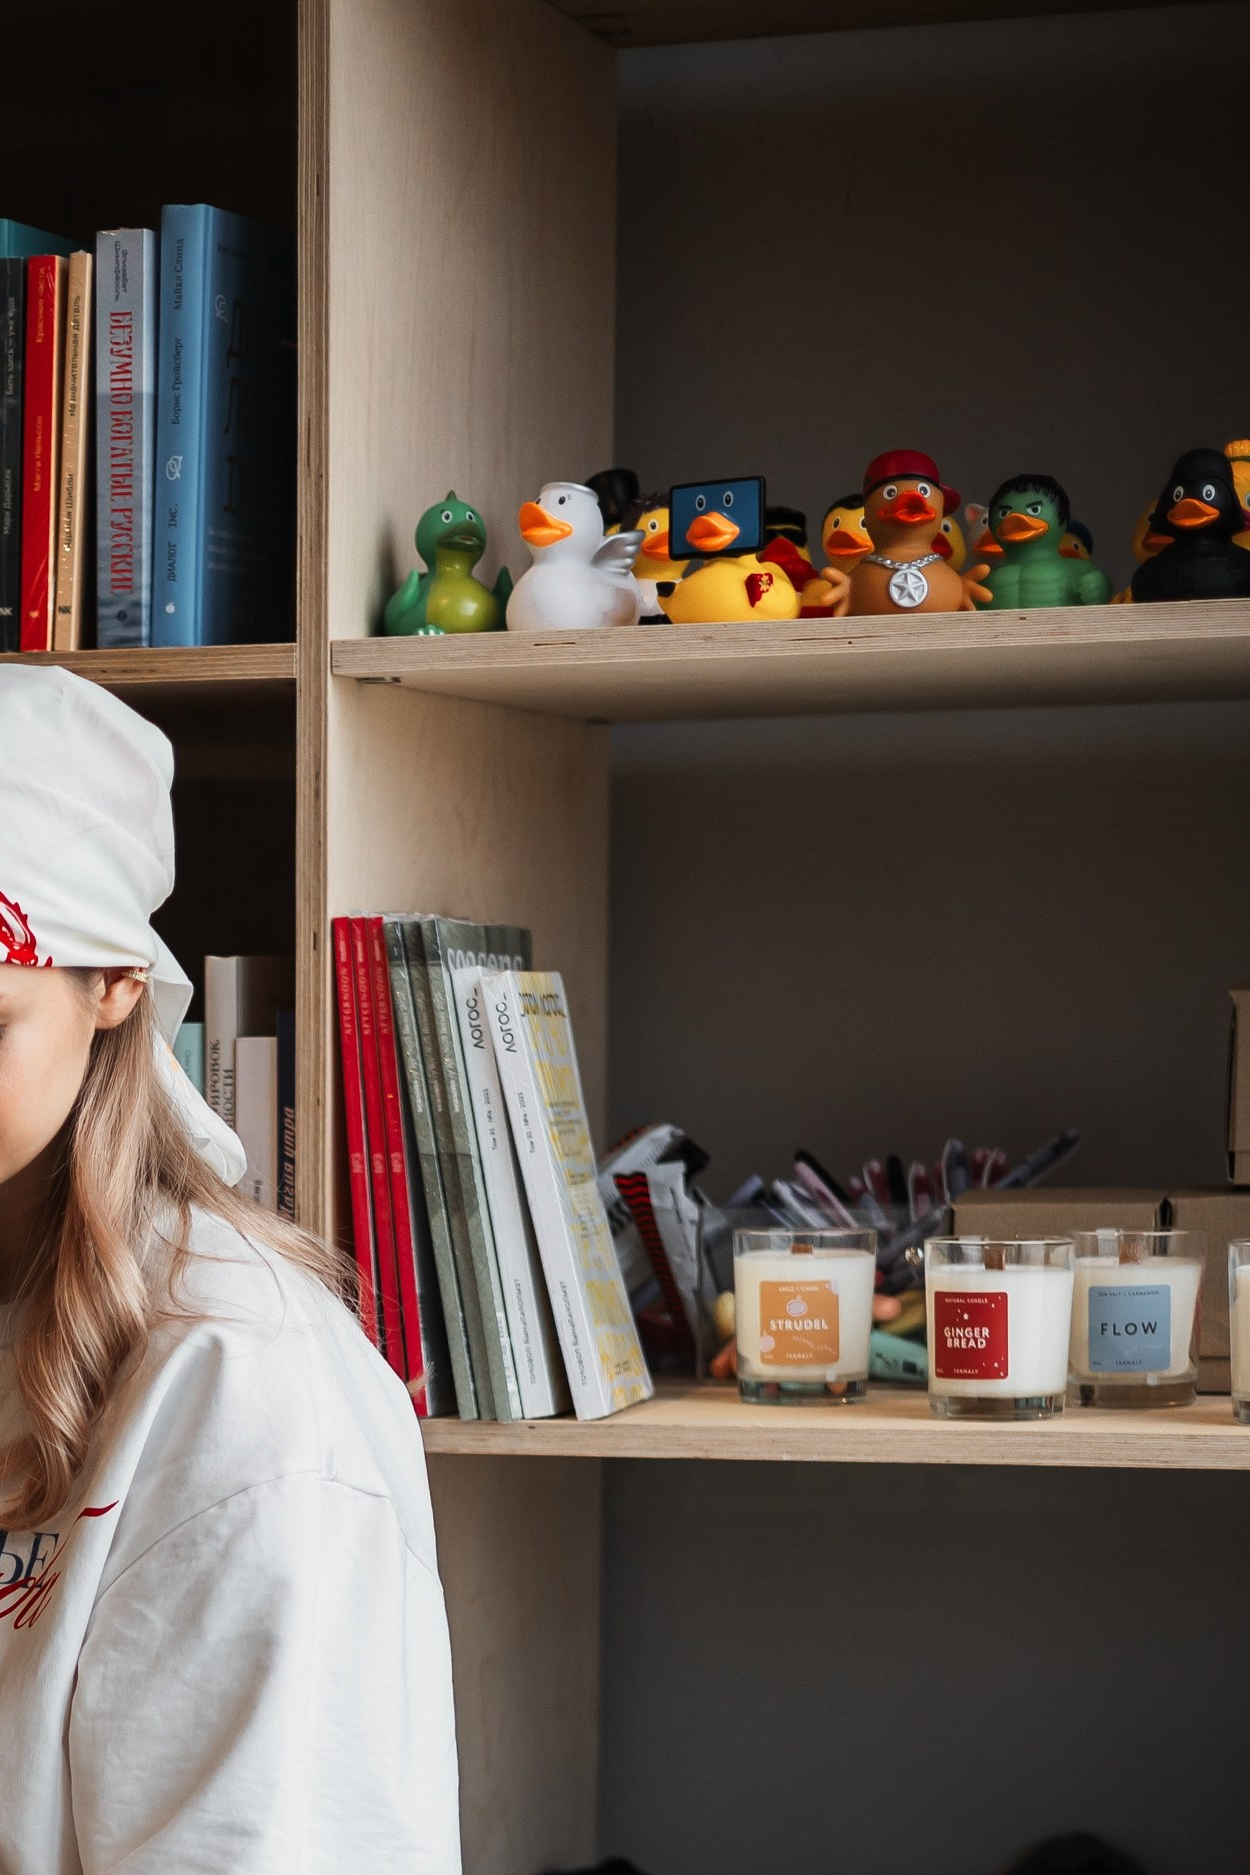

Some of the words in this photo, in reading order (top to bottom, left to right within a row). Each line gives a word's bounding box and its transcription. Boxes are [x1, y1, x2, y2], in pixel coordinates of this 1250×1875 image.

[174, 238, 185, 274] Слинд
[173, 277, 184, 310] Майкл
[35, 299, 47, 343] Красные
[70, 296, 81, 331] деталь
[5, 349, 16, 372] здесь
[109, 310, 134, 405] БЕЗУМНО
[172, 337, 185, 391] Гройсберг
[5, 374, 15, 395] Быть
[171, 395, 182, 425] Борис
[110, 410, 134, 502] БОГАТЫЕ
[64, 473, 74, 509] Шибли
[168, 503, 179, 528] INC.
[110, 507, 135, 596] РУССКИЕ
[167, 542, 178, 582] ДИАЛОГ
[341, 967, 352, 1035] AFTERNOON
[358, 968, 371, 1035] AFTERNOON
[769, 1319, 829, 1331] STRUDEL
[944, 1327, 990, 1338] GINGER
[1100, 1321, 1158, 1336] FLOW
[946, 1338, 986, 1349] BREAD
